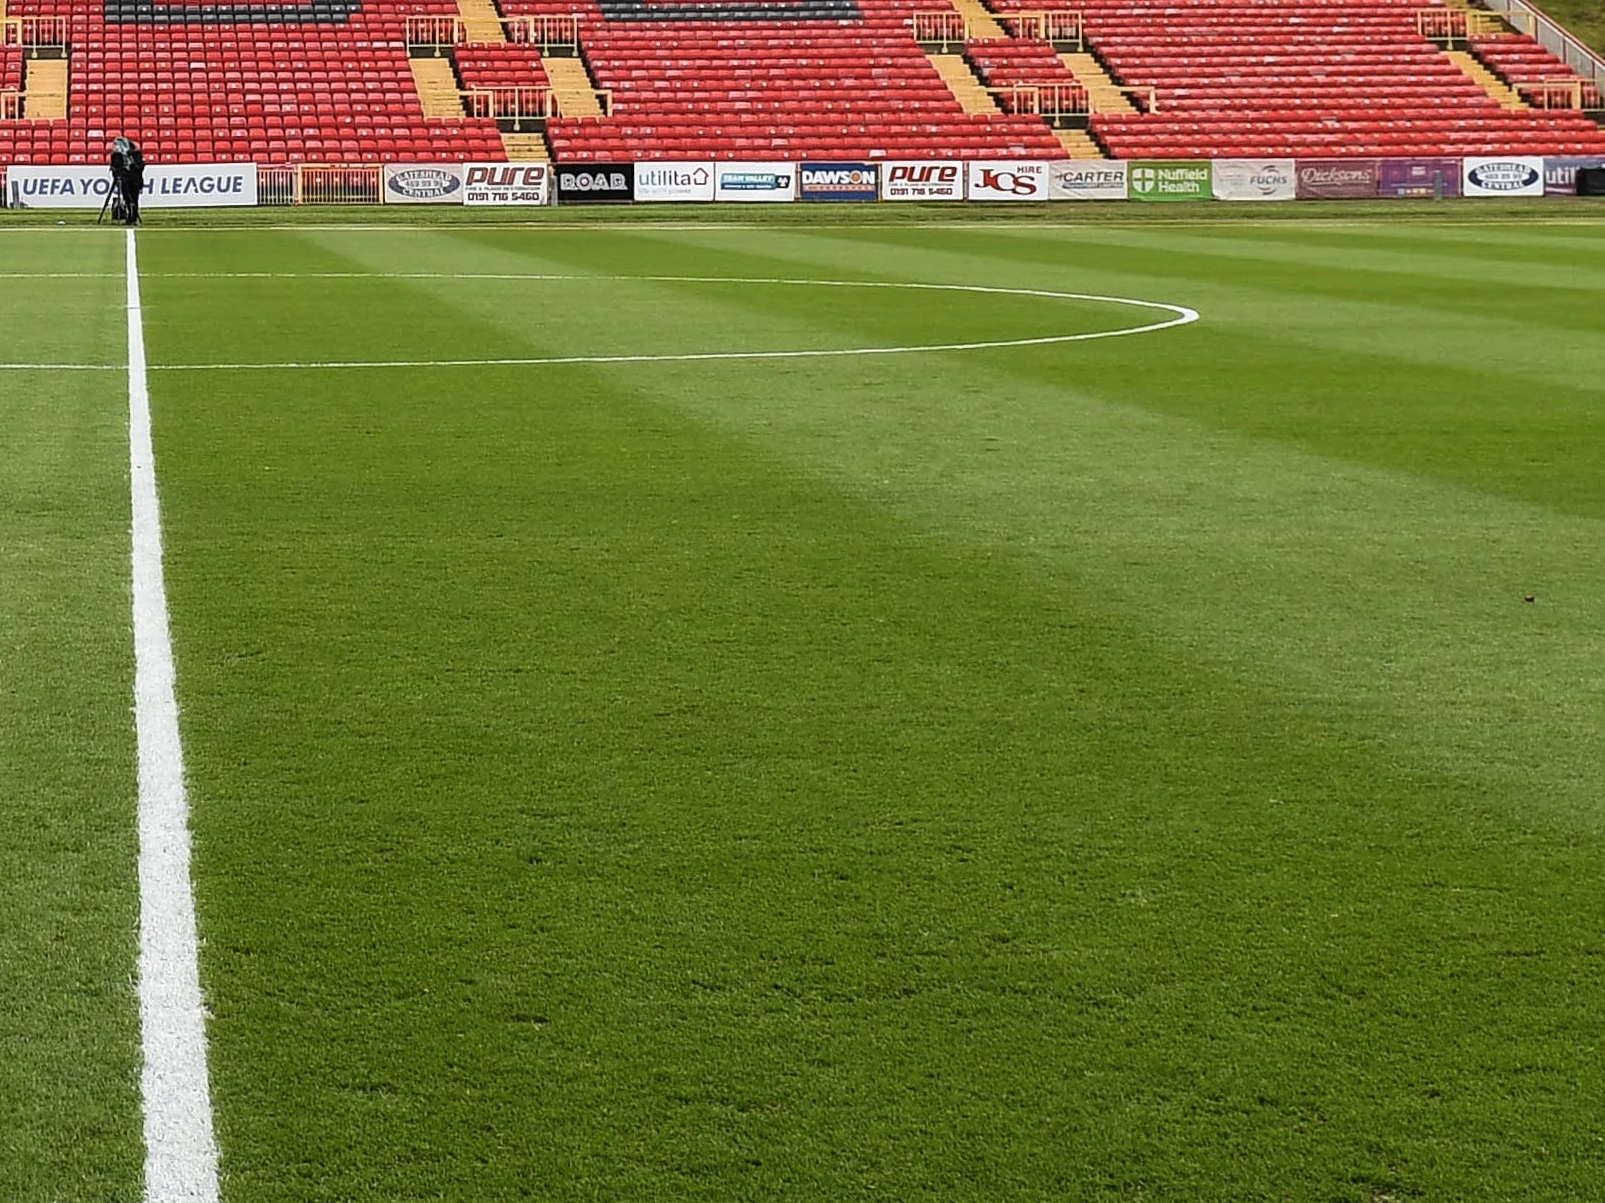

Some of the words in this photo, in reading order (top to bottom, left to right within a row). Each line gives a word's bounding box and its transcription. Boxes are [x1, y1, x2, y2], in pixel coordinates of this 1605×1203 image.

[1016, 165, 1043, 174] HIRE
[1158, 168, 1208, 180] Nuffield
[395, 170, 452, 181] GATESHEAD
[638, 170, 691, 186] utilita
[723, 175, 744, 183] TEAM
[745, 175, 774, 183] VALLEY
[801, 170, 876, 184] DAWSON
[1062, 171, 1124, 182] CARTER
[1250, 175, 1288, 185] FUCHS
[1301, 167, 1372, 184] Dicksons
[23, 178, 75, 195] UEFA
[80, 178, 154, 195] YOH
[161, 176, 243, 194] LEAGUE
[560, 173, 628, 190] ROAR
[1158, 181, 1200, 193] Health
[402, 187, 447, 198] CENTRAL
[467, 192, 489, 201] 0191
[492, 192, 508, 201] 716
[511, 192, 540, 201] 5460
